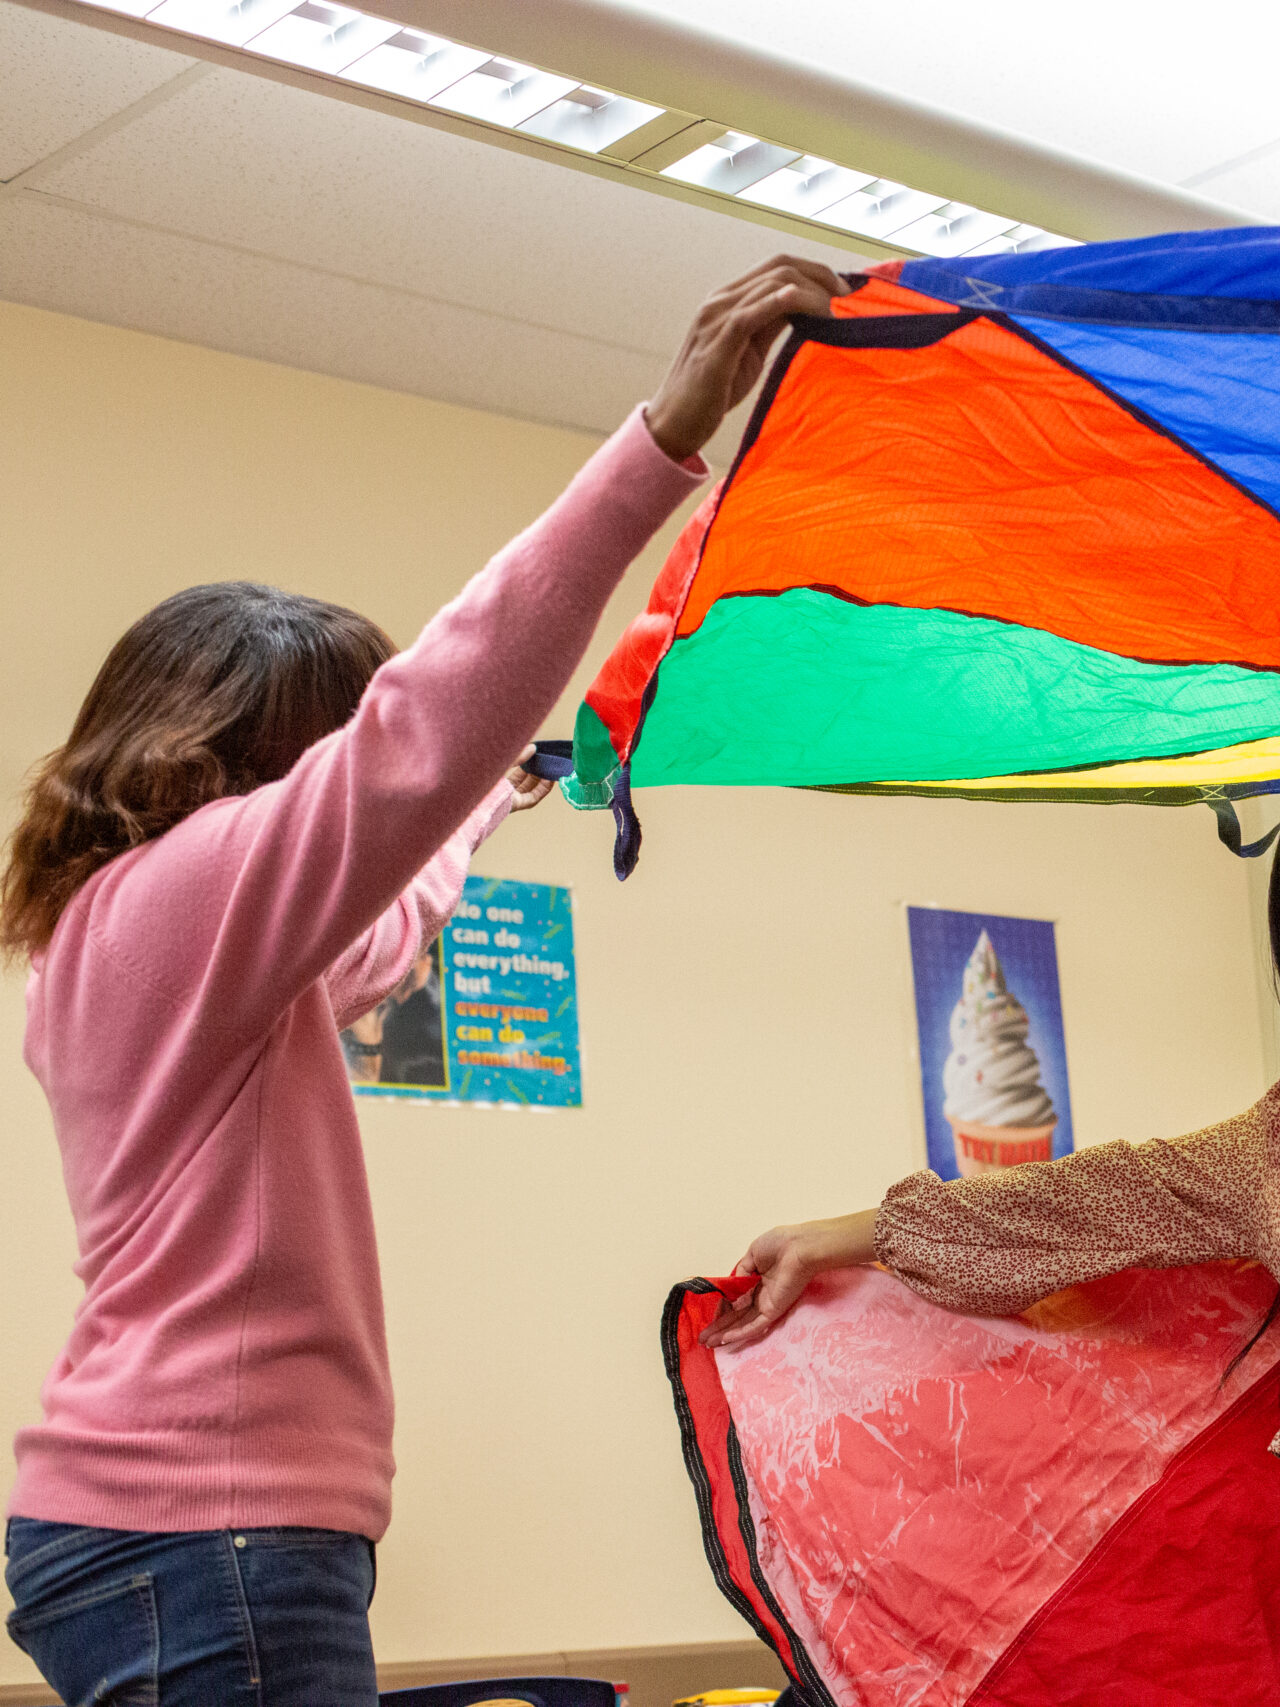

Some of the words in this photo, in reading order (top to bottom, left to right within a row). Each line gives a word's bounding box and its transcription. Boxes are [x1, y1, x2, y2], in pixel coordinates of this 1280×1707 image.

[486, 907, 524, 924] one
[452, 927, 489, 946] can
[494, 927, 521, 949] do
[455, 972, 491, 994] but
[455, 1002, 548, 1023] everyone
[456, 1025, 493, 1042] can
[498, 1023, 526, 1044] do
